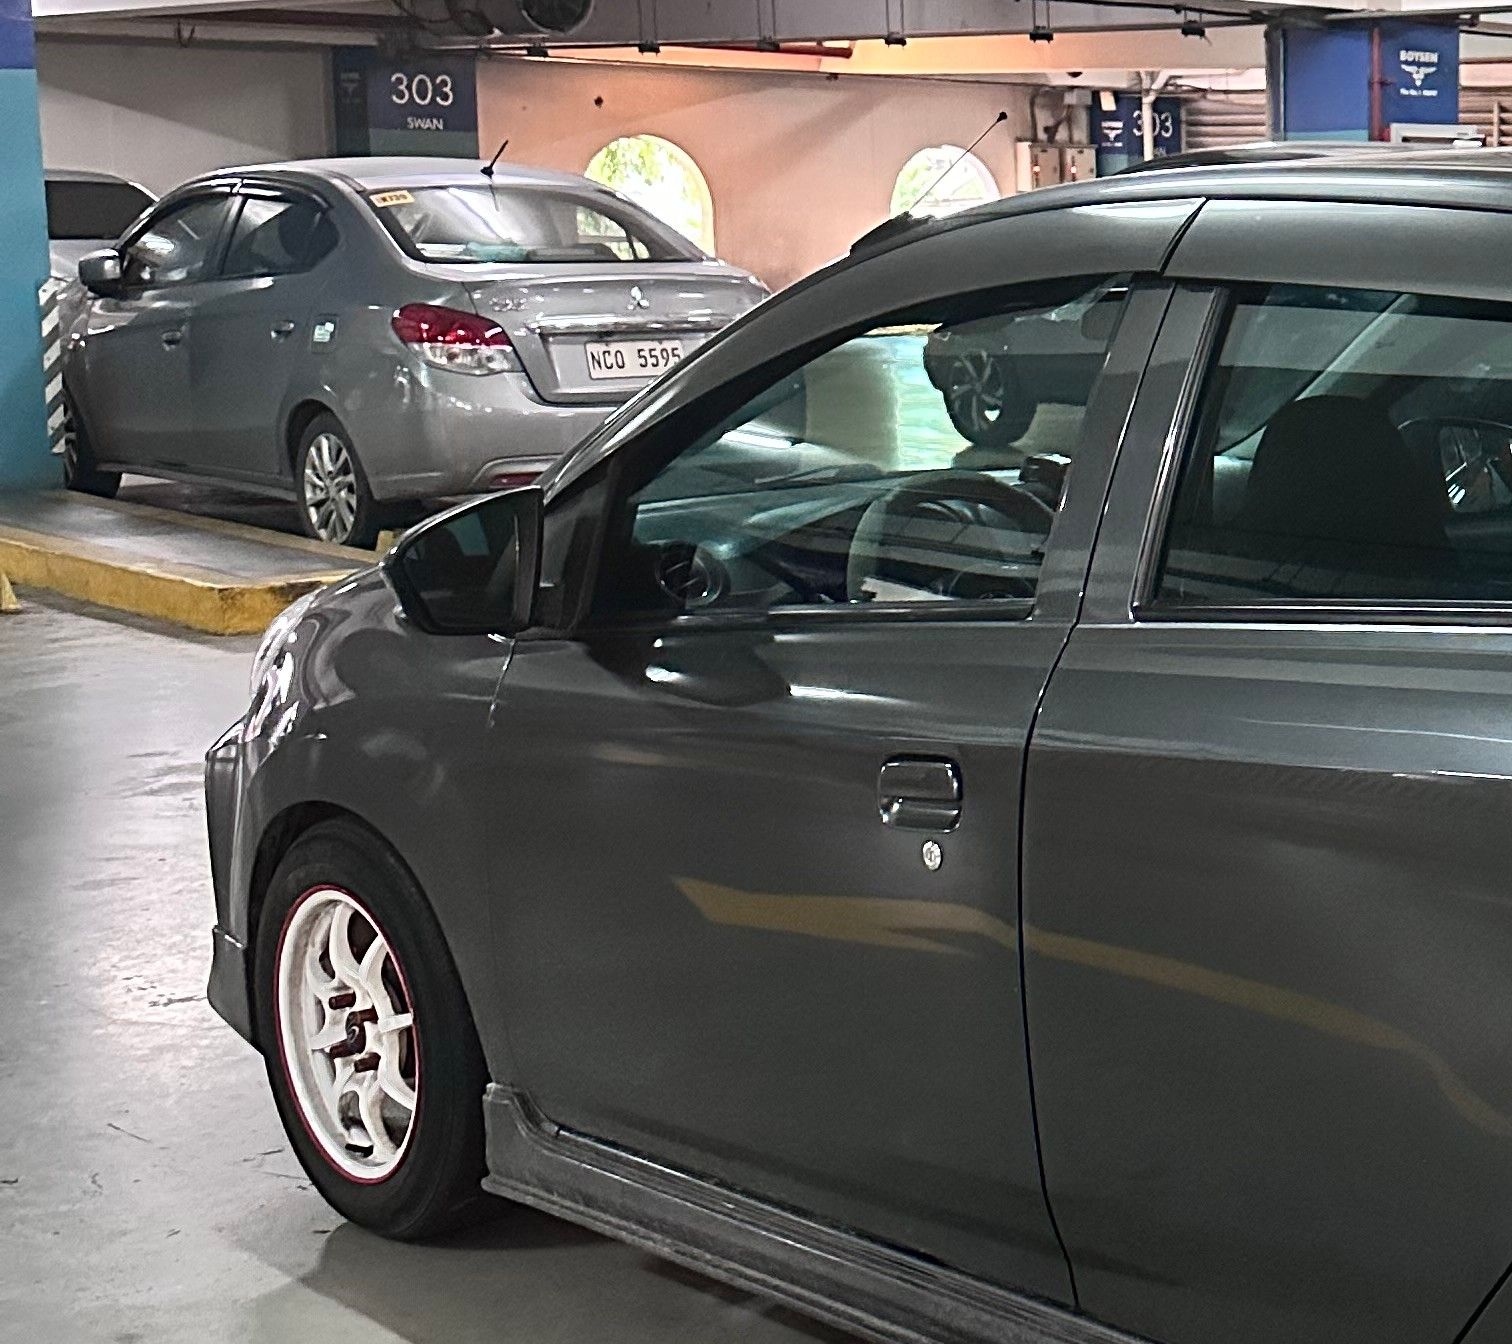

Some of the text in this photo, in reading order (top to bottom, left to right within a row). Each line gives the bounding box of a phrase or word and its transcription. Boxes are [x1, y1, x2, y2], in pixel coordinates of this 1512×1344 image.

[391, 72, 454, 106] 303
[407, 117, 444, 130] SWAN
[590, 347, 681, 370] NCO 5595
